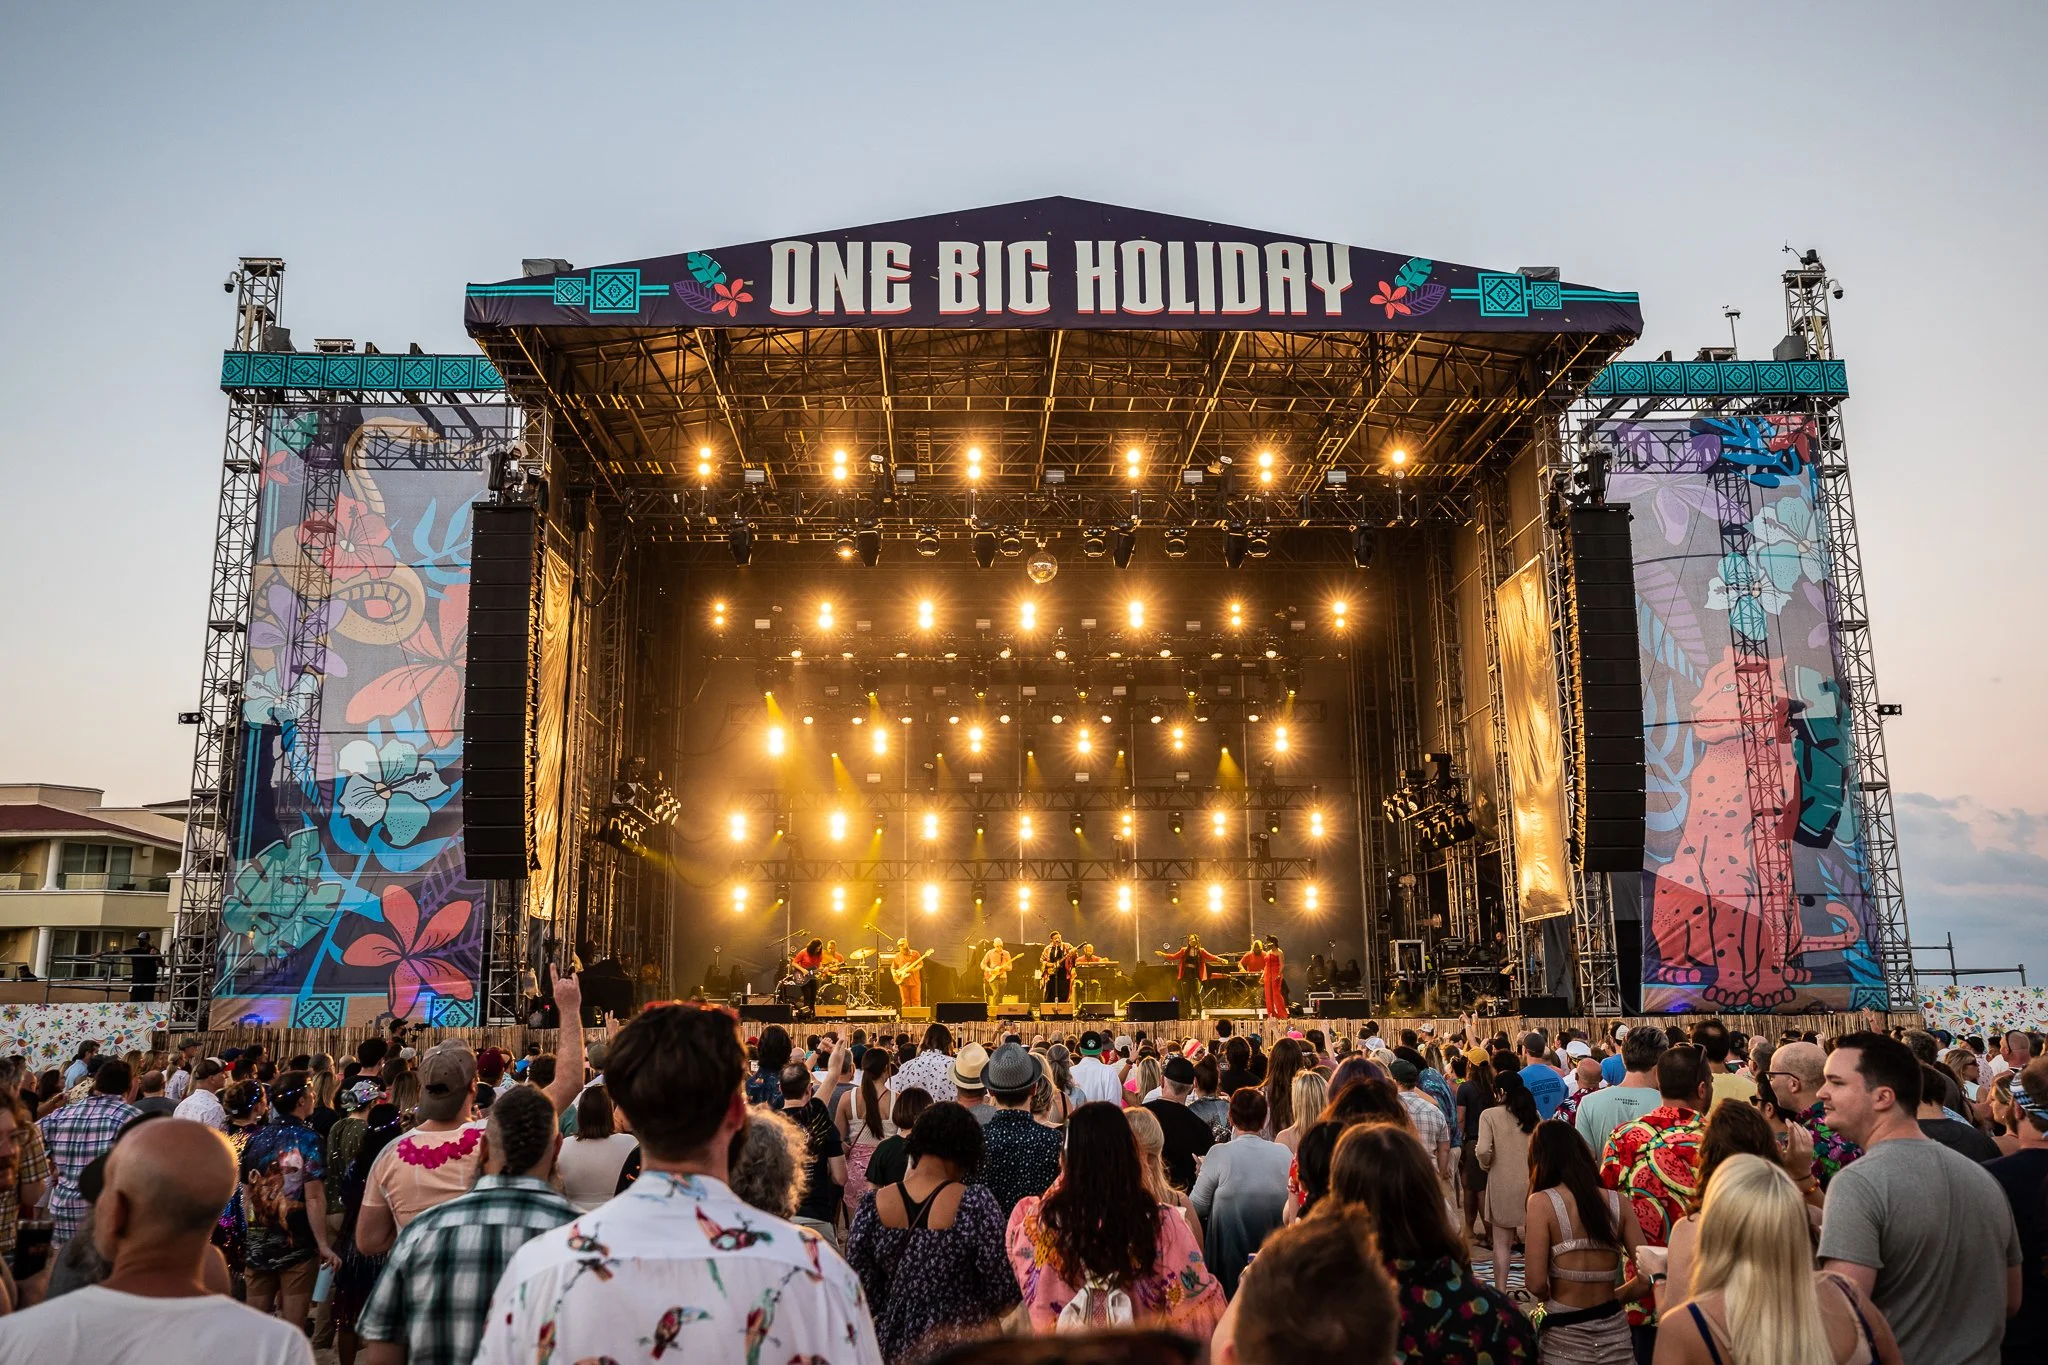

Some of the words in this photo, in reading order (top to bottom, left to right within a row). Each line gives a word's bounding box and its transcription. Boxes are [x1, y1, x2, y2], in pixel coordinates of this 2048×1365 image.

[769, 241, 912, 316] ONE
[938, 240, 1051, 316] BIG
[1074, 240, 1354, 316] HOLIDAY
